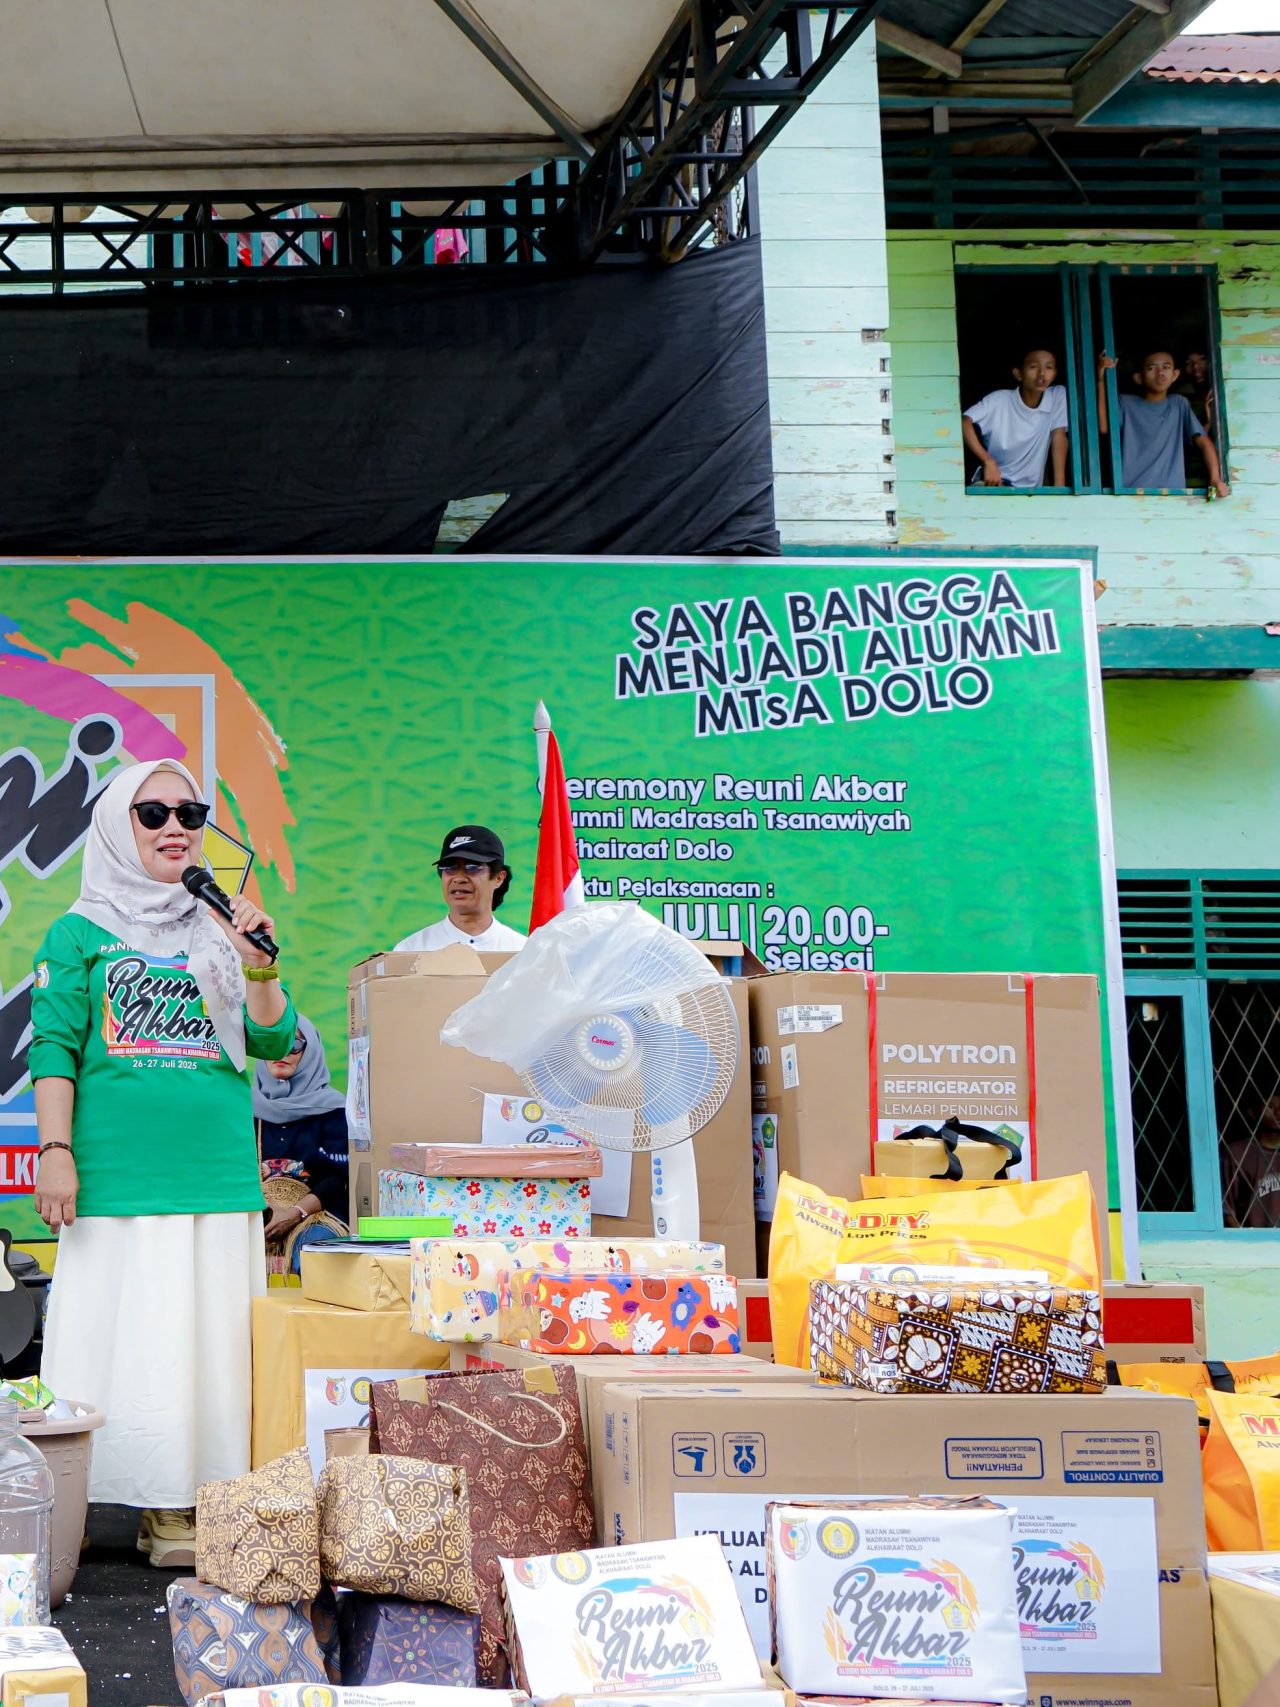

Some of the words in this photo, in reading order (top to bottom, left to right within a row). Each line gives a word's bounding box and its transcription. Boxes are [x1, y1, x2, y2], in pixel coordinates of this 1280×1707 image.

[633, 595, 777, 649] SAYA
[786, 571, 1025, 635] BANGGA
[617, 632, 846, 699] MENJADI
[861, 610, 1060, 672] ALUMNI
[695, 683, 830, 736] MTsA
[841, 664, 991, 721] DOLO
[538, 774, 705, 805] eremony
[714, 774, 802, 802] Reuni
[811, 774, 907, 802] Akbar
[539, 808, 624, 829] umni
[631, 808, 757, 830] Madrasah
[764, 808, 910, 834] Tsanawiyah
[676, 837, 733, 860] Dolo
[617, 878, 761, 899] Pelaksanaan
[764, 945, 874, 972] Selesai
[201, 1040, 220, 1051] 2025
[132, 1059, 158, 1068] 26-27
[160, 1059, 176, 1068] Juli
[177, 1061, 197, 1070] 2025
[883, 1080, 1017, 1095] REFRIGERATOR
[884, 1103, 936, 1115] LEMARI
[941, 1103, 1018, 1116] PENDINGIN
[1069, 1472, 1116, 1481] CONTROL
[1120, 1472, 1159, 1481] QUALITY
[833, 1567, 945, 1625] Reuni
[576, 1589, 680, 1642] Reuni
[1077, 1622, 1097, 1631] 2025
[847, 1612, 970, 1664] Akbar
[601, 1630, 711, 1681] Akbar
[946, 1656, 972, 1667] 2025
[693, 1662, 719, 1674] 2025
